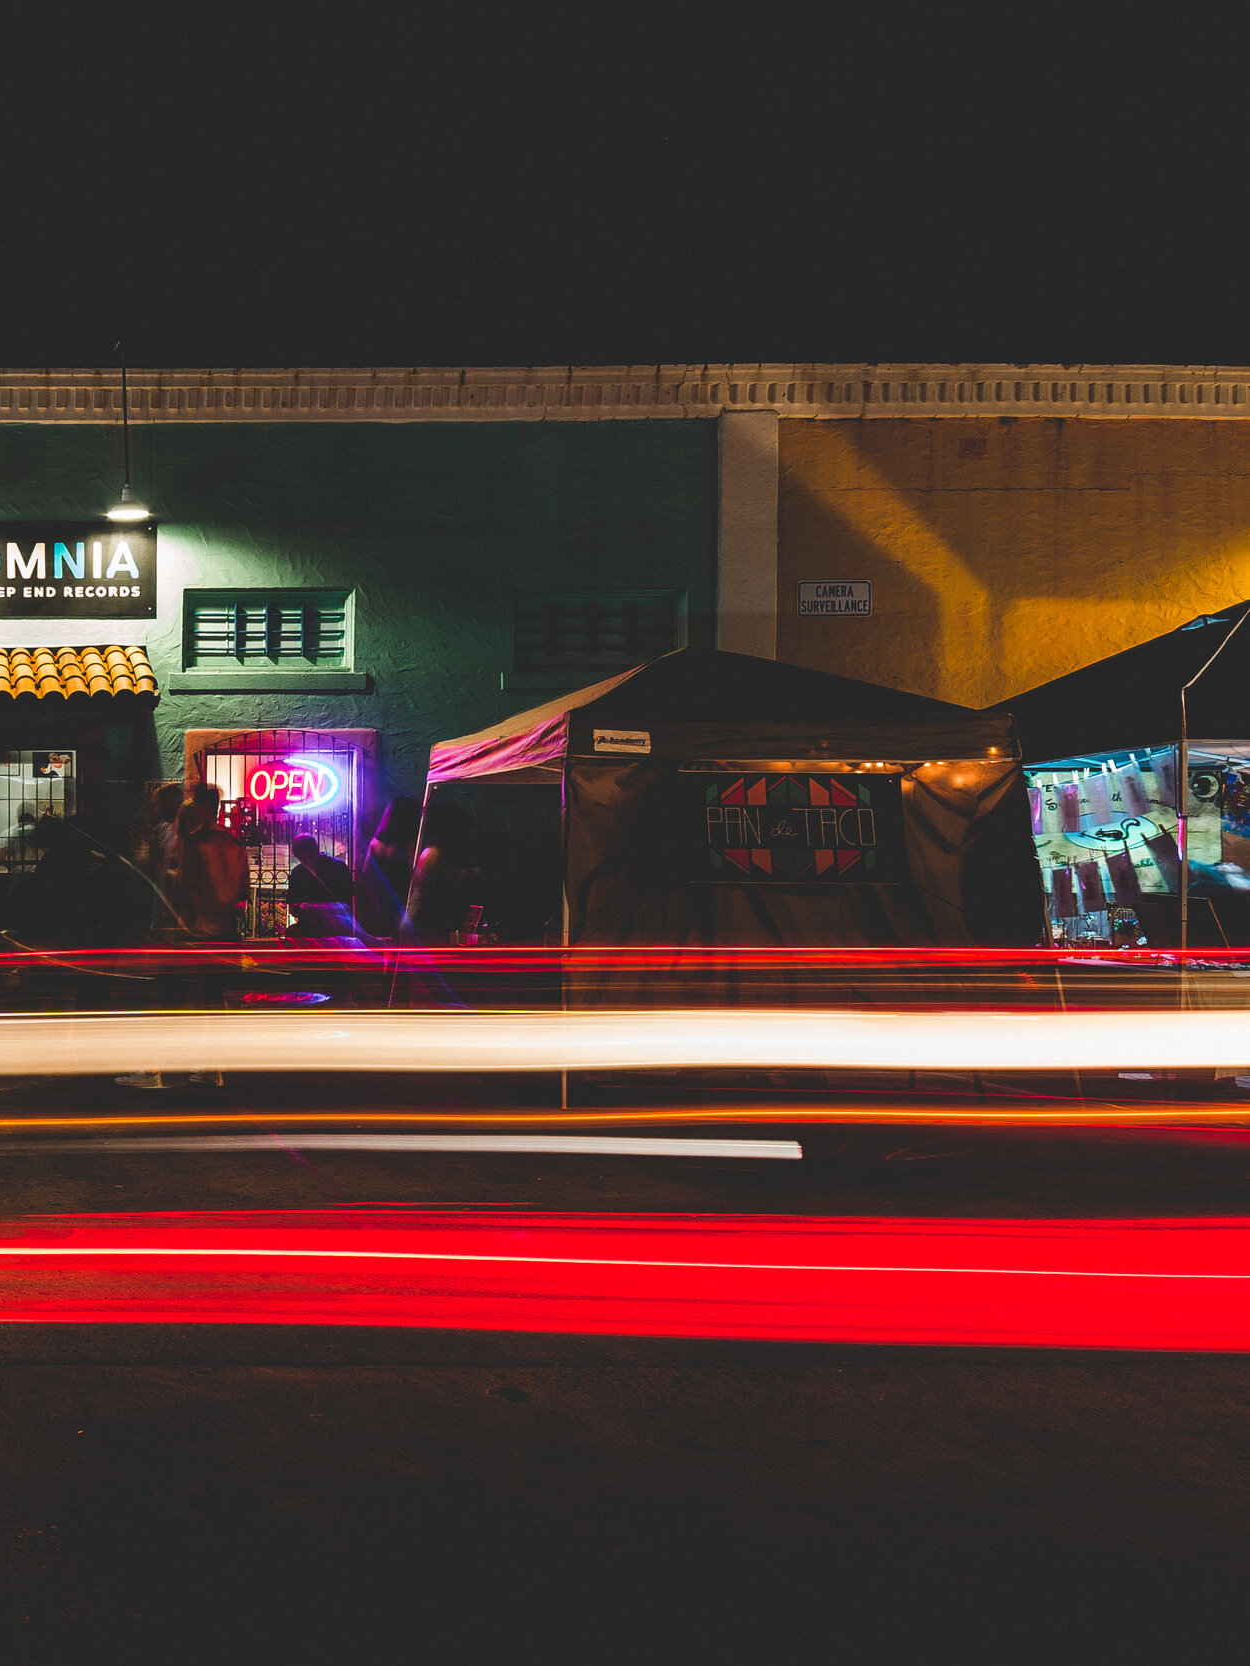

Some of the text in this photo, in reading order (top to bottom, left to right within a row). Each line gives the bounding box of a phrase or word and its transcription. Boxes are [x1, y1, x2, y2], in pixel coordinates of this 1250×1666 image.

[22, 585, 57, 599] END
[62, 585, 141, 599] RECORDS
[815, 585, 854, 598] CAMERA
[800, 600, 868, 613] SURVEILLANCE
[609, 736, 646, 747] Academy
[249, 770, 323, 801] OPEN
[706, 806, 877, 846] PAN de TACO
